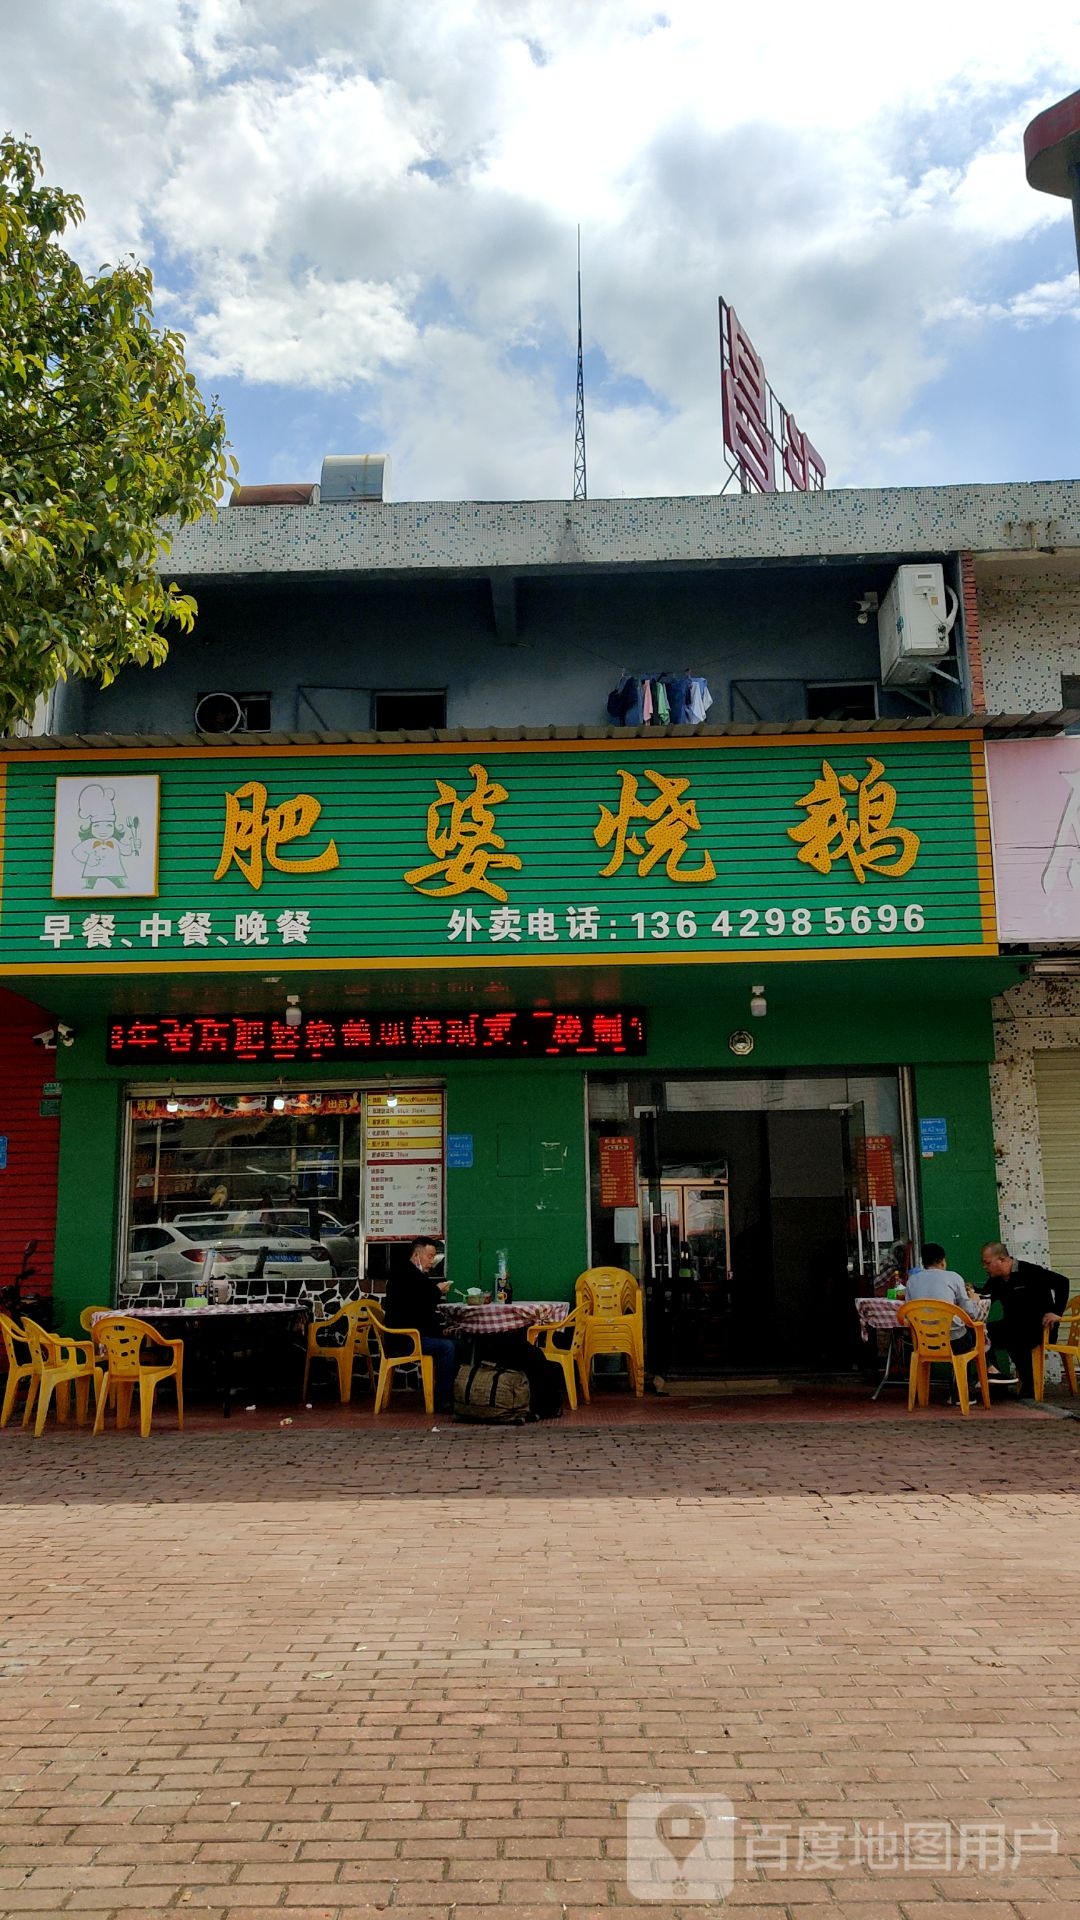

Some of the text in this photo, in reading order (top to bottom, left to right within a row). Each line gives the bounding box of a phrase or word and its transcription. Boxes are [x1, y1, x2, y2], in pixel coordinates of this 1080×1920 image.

[212, 757, 920, 902] 肥婆烧鹅
[39, 909, 312, 949] 早餐、中餐、晚餐
